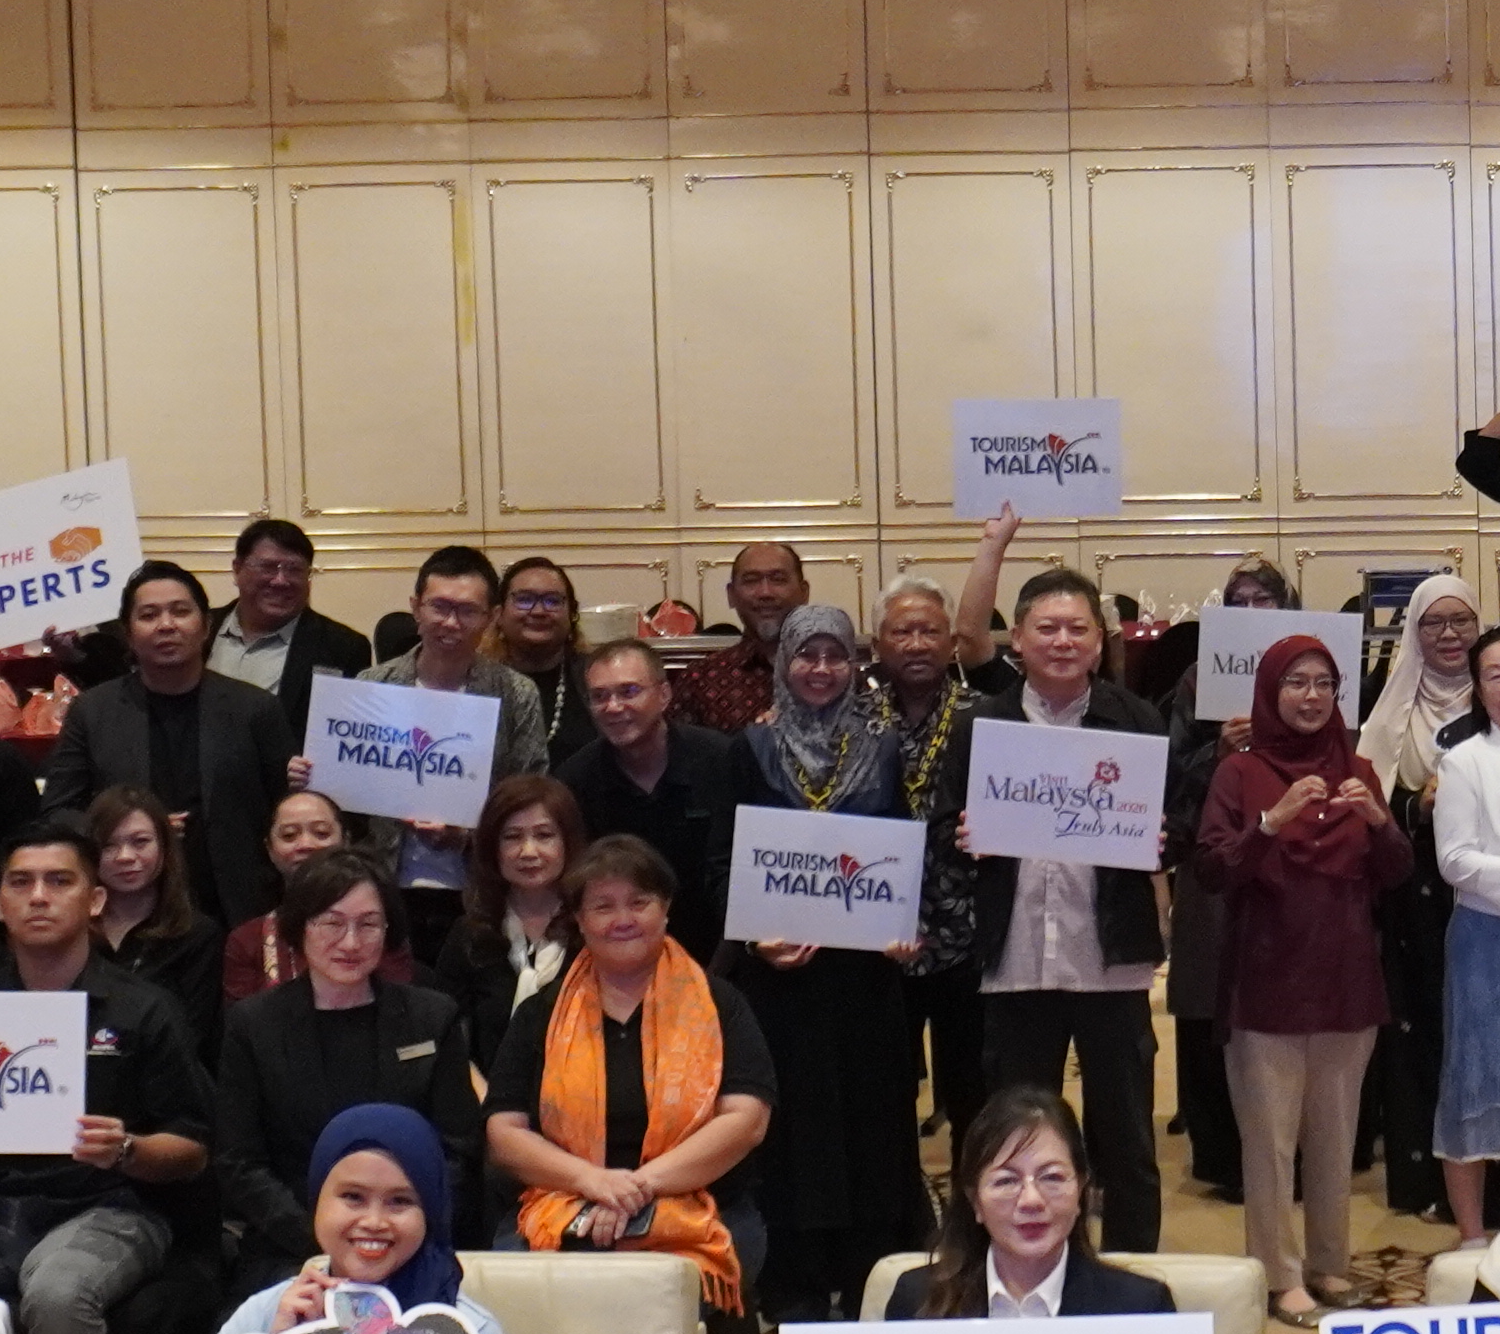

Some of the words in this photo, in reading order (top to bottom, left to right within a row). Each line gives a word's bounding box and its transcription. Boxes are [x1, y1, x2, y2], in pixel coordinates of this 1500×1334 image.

[970, 437, 1047, 452] TOURISM
[985, 453, 1098, 486] MALAYSIA
[0, 547, 35, 567] THE
[326, 718, 411, 745] TOURISM
[338, 741, 463, 786] MALAYSIA
[985, 775, 1114, 812] Malaysia
[1055, 810, 1106, 838] Truly
[1108, 821, 1145, 838] Asia
[753, 848, 838, 873] TOURISM
[764, 871, 892, 912] MALAYSIA
